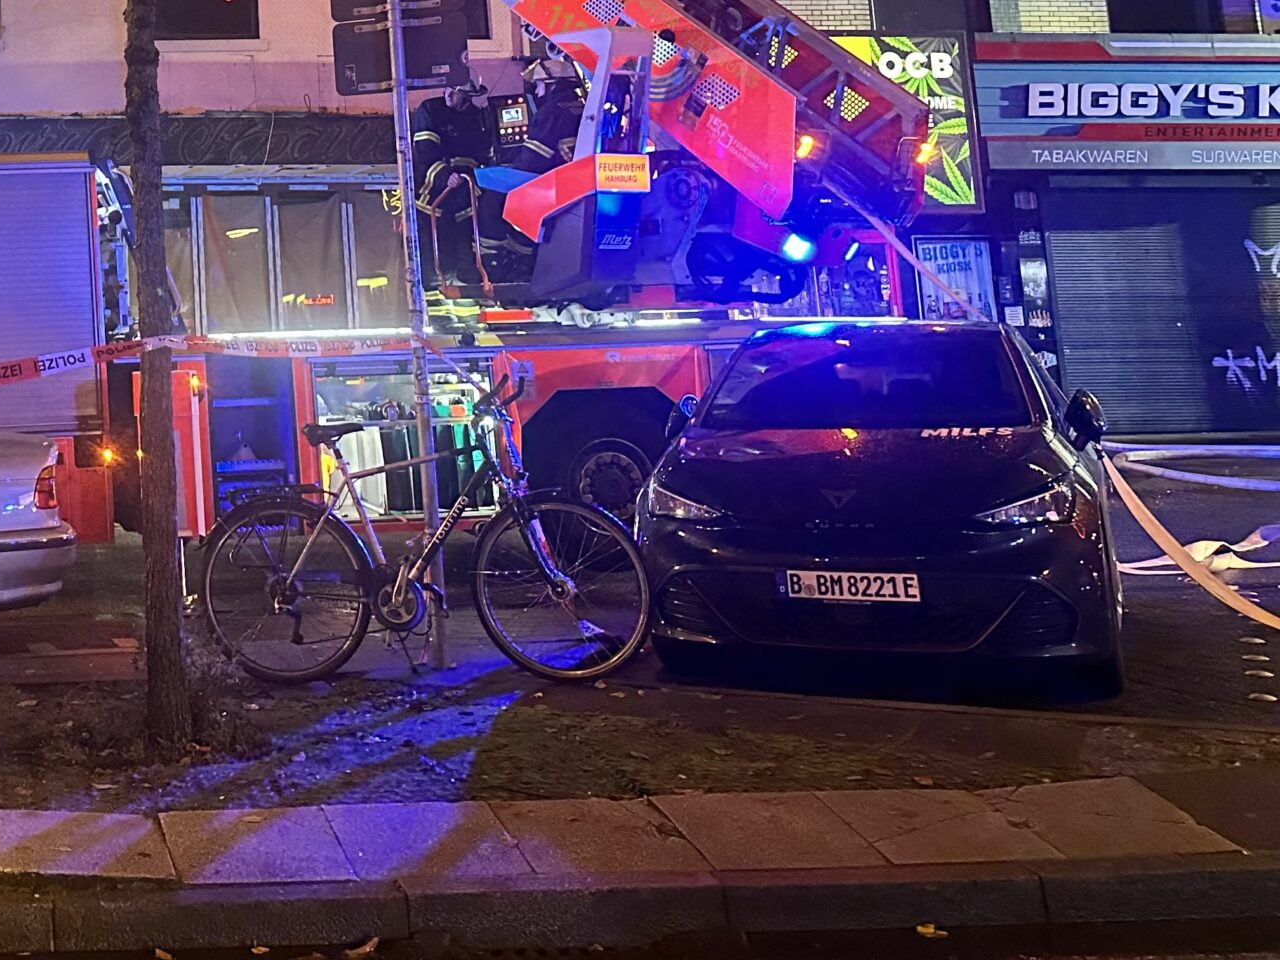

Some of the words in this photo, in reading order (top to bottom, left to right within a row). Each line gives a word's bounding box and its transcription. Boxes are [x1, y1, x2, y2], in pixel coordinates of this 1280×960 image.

[878, 51, 954, 79] OCB
[1027, 83, 1245, 117] BIGGY'S
[1032, 149, 1148, 164] TABAKWAREN
[598, 162, 646, 173] FEUERWEHR
[604, 174, 638, 184] HAMBURG
[922, 243, 983, 261] BIGGYS
[34, 352, 86, 373] POLIZEI
[789, 573, 803, 595] B
